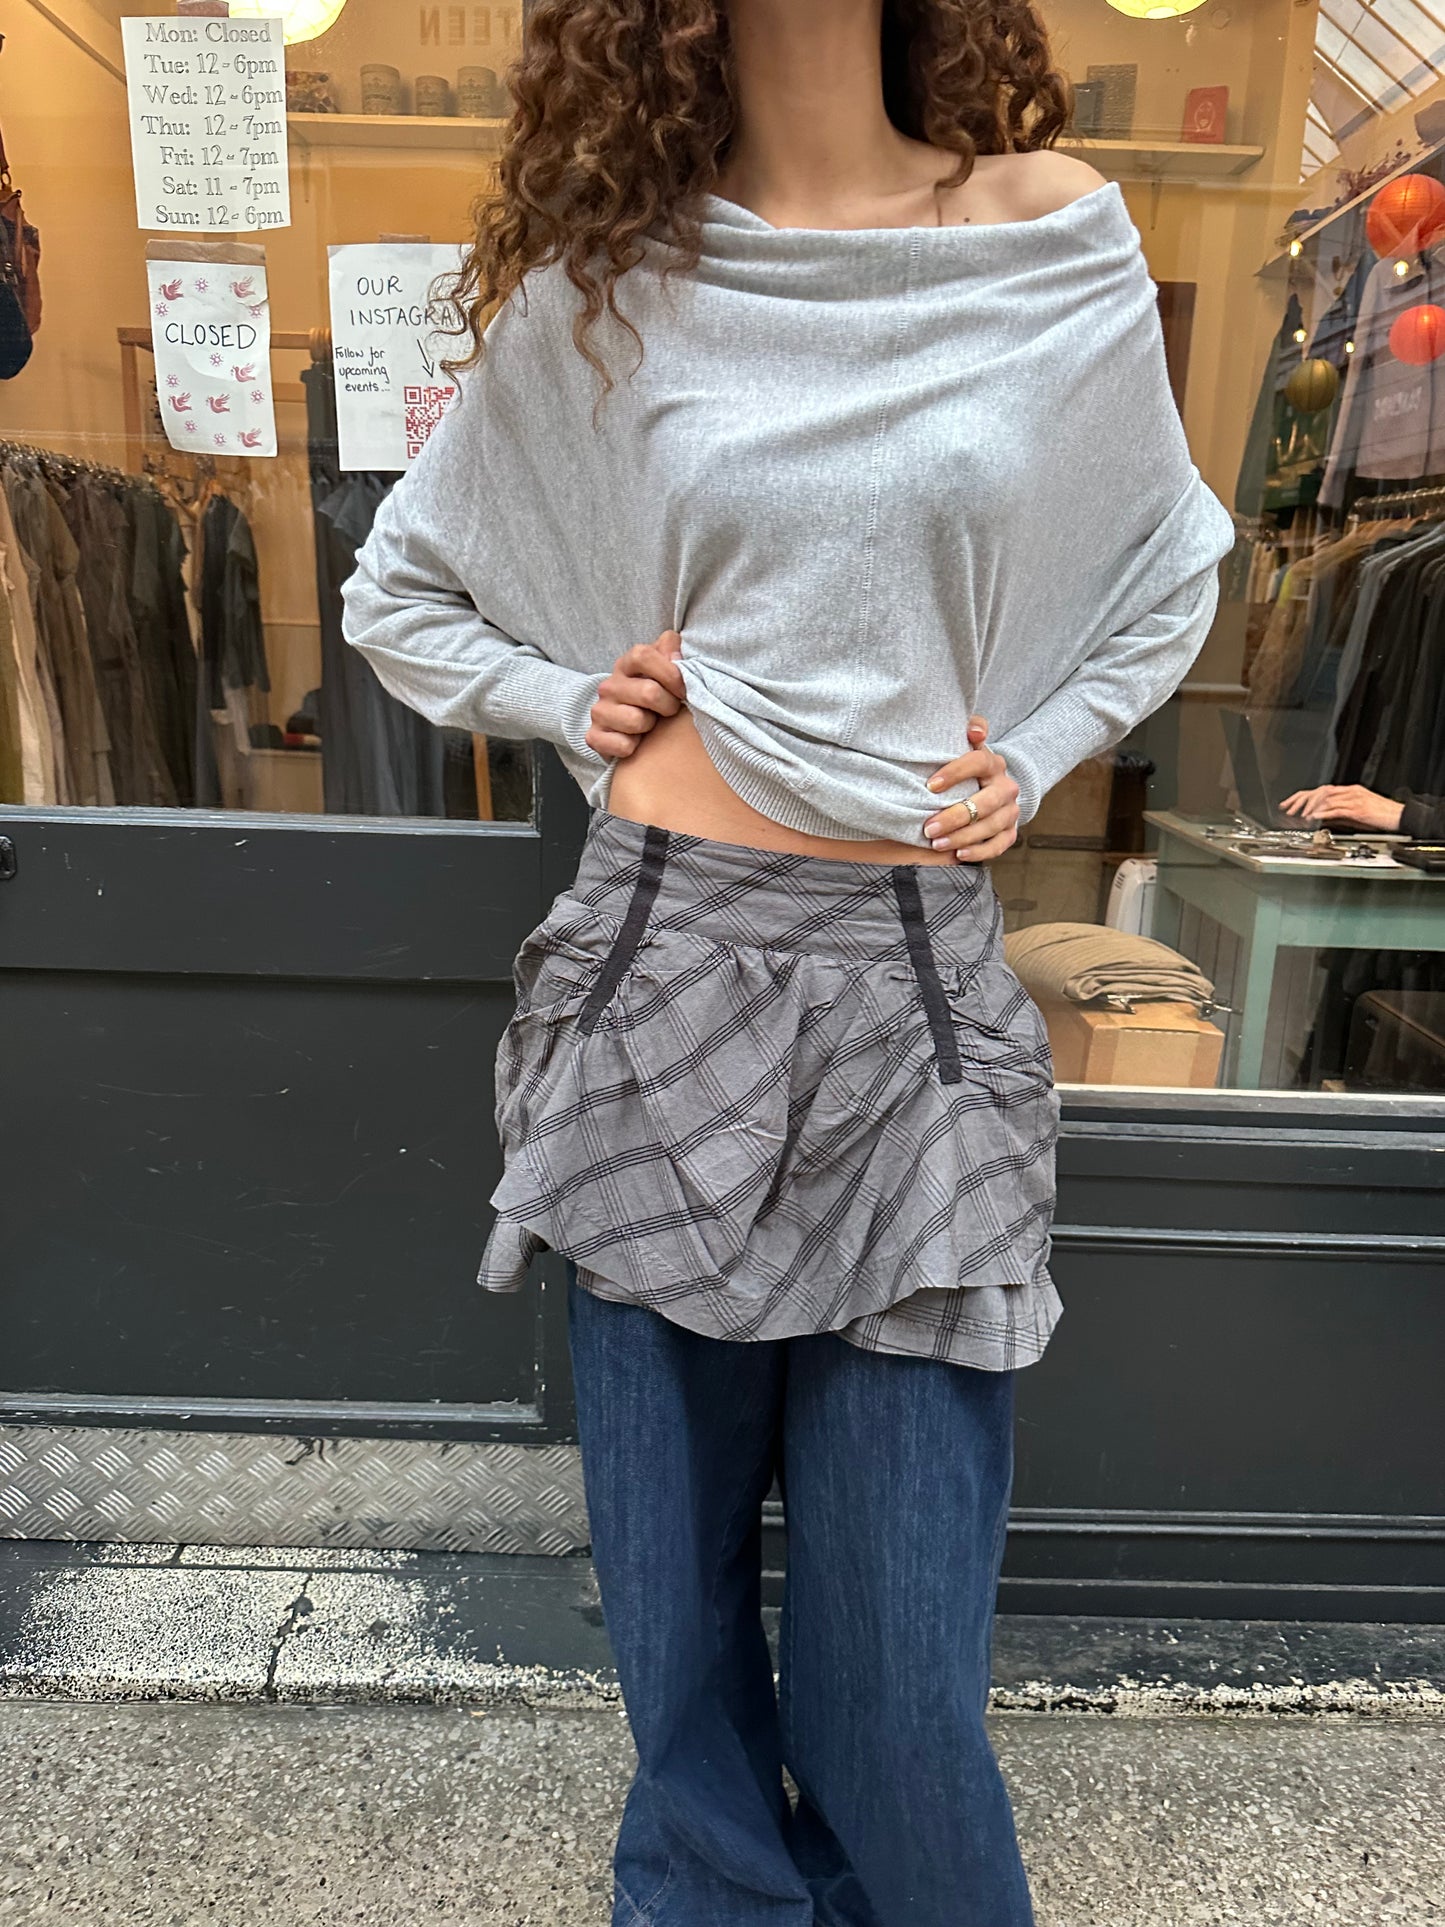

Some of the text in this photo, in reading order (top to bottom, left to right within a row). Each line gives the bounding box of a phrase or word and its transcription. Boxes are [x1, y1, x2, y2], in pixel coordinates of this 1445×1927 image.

[145, 22, 272, 43] Mon: Closed
[144, 54, 190, 74] Tue:
[142, 85, 198, 105] Wed:
[140, 115, 191, 135] Thu:
[160, 146, 194, 166] Fri:
[162, 176, 198, 195] Sat:
[155, 205, 200, 225] Sun:
[357, 275, 404, 296] OUR
[350, 305, 463, 327] INSTAGRA
[165, 322, 257, 350] CLOSED
[335, 346, 386, 367] Follow for
[338, 366, 390, 384] upcoming
